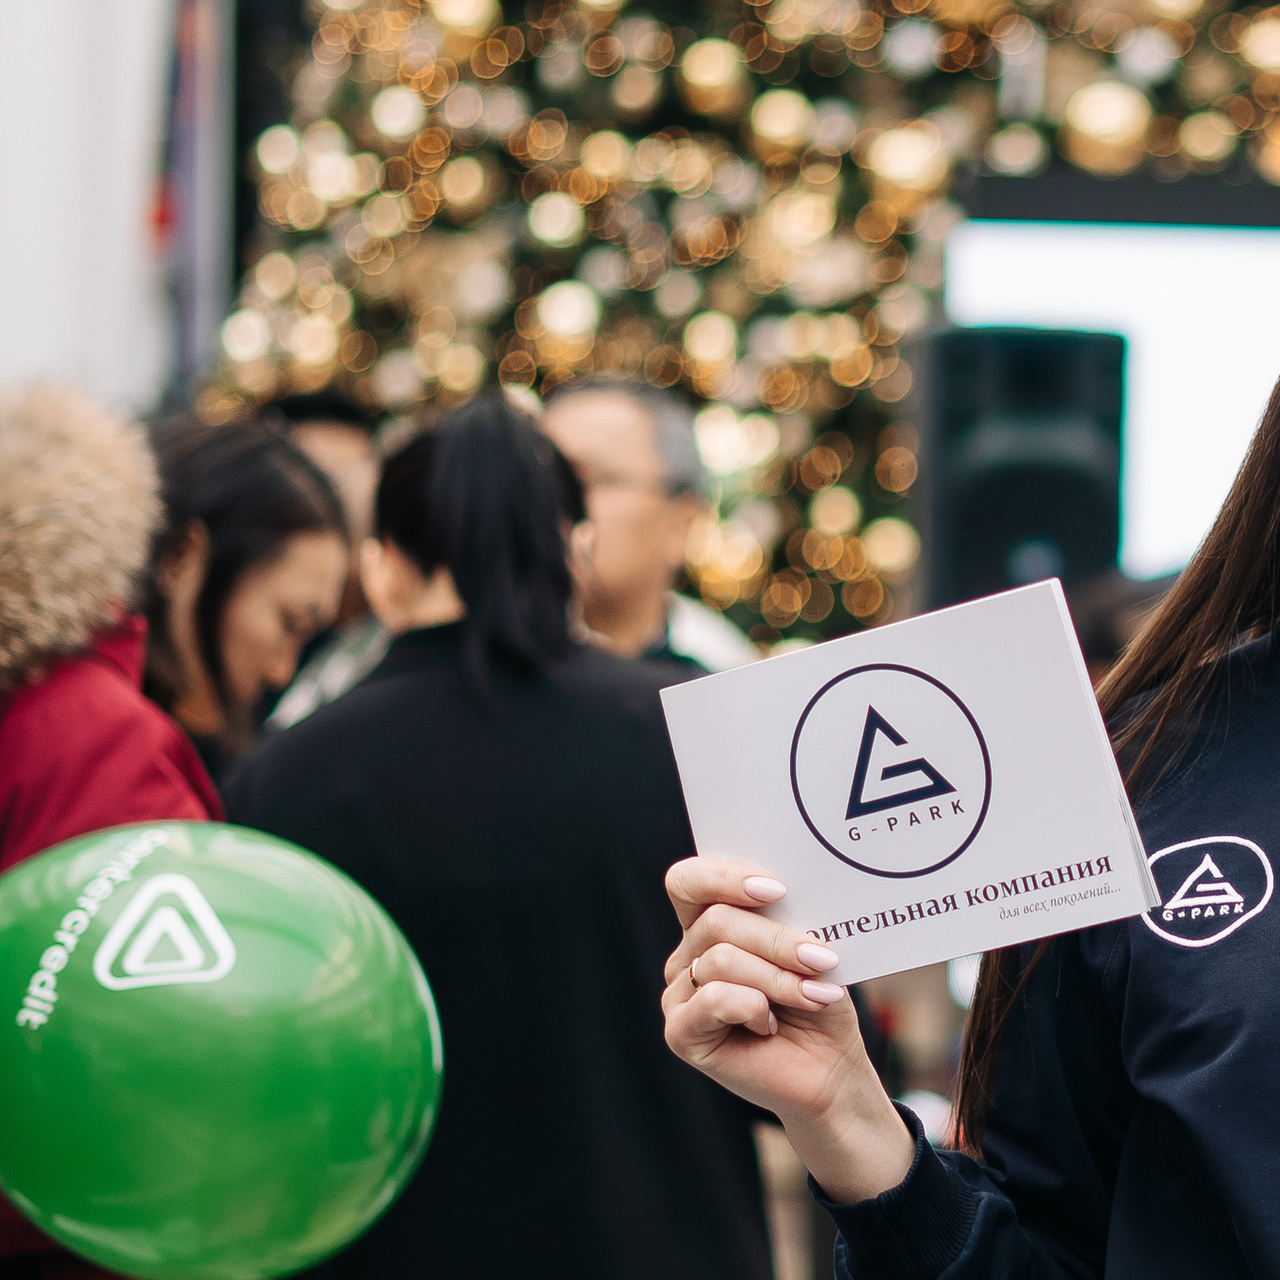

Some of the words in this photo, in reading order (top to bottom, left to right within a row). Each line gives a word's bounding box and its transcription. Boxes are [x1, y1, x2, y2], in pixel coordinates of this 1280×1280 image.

[848, 799, 965, 841] G-PARK
[964, 854, 1114, 907] компания
[999, 906, 1020, 920] для
[1023, 900, 1050, 914] всех
[1050, 882, 1121, 907] поколений...
[1162, 902, 1244, 921] G-PARK
